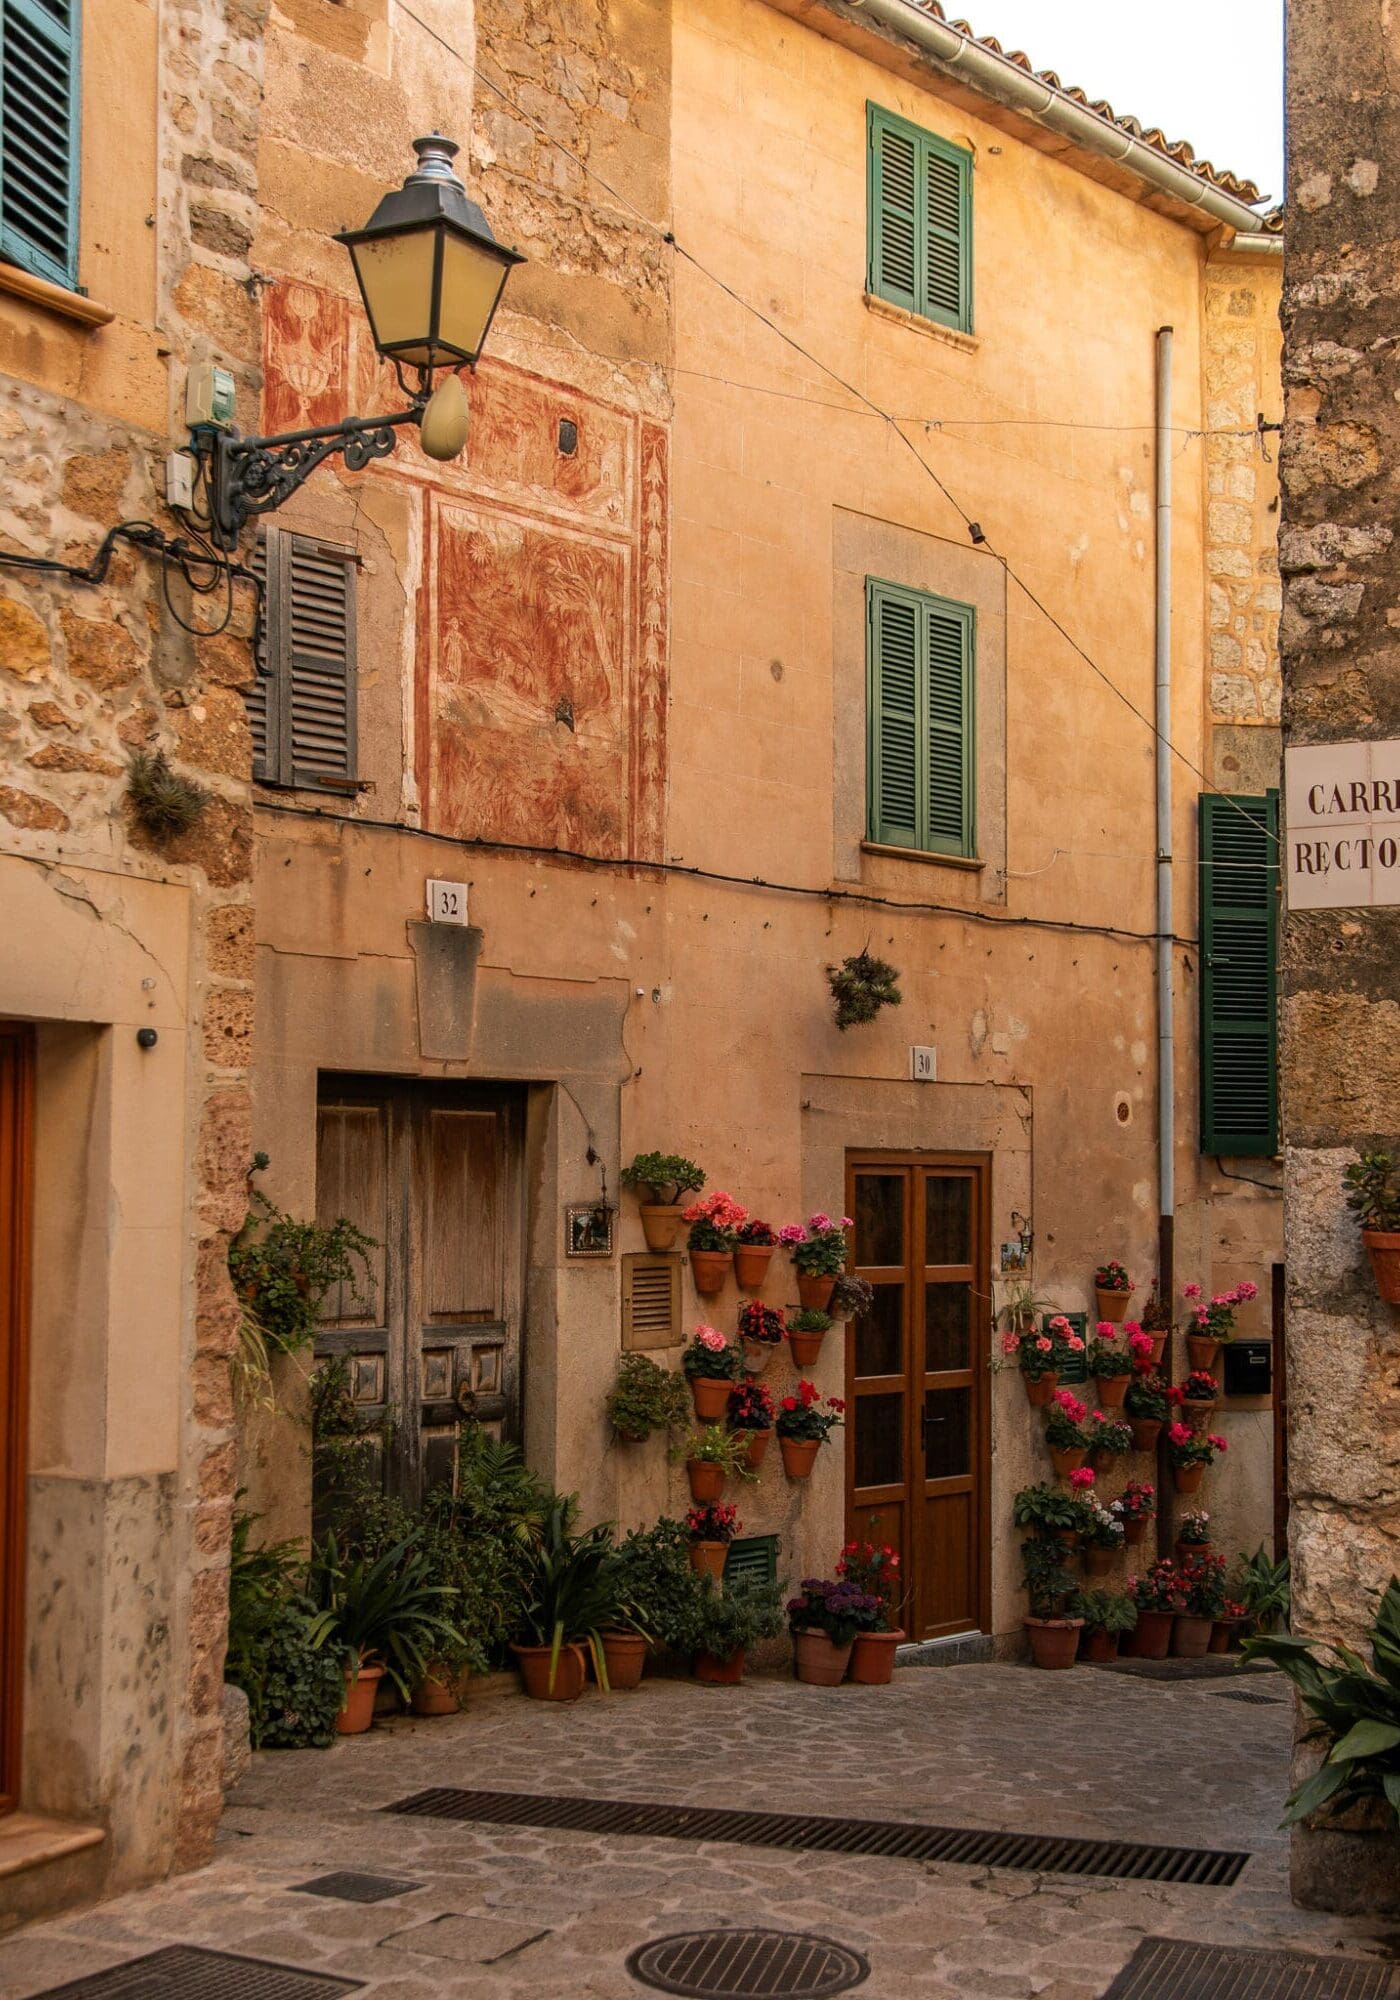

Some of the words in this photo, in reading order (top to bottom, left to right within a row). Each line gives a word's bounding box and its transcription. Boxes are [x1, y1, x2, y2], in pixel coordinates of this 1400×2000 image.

[1294, 837, 1400, 875] RECTO
[441, 892, 457, 915] 32
[919, 1054, 931, 1074] 30
